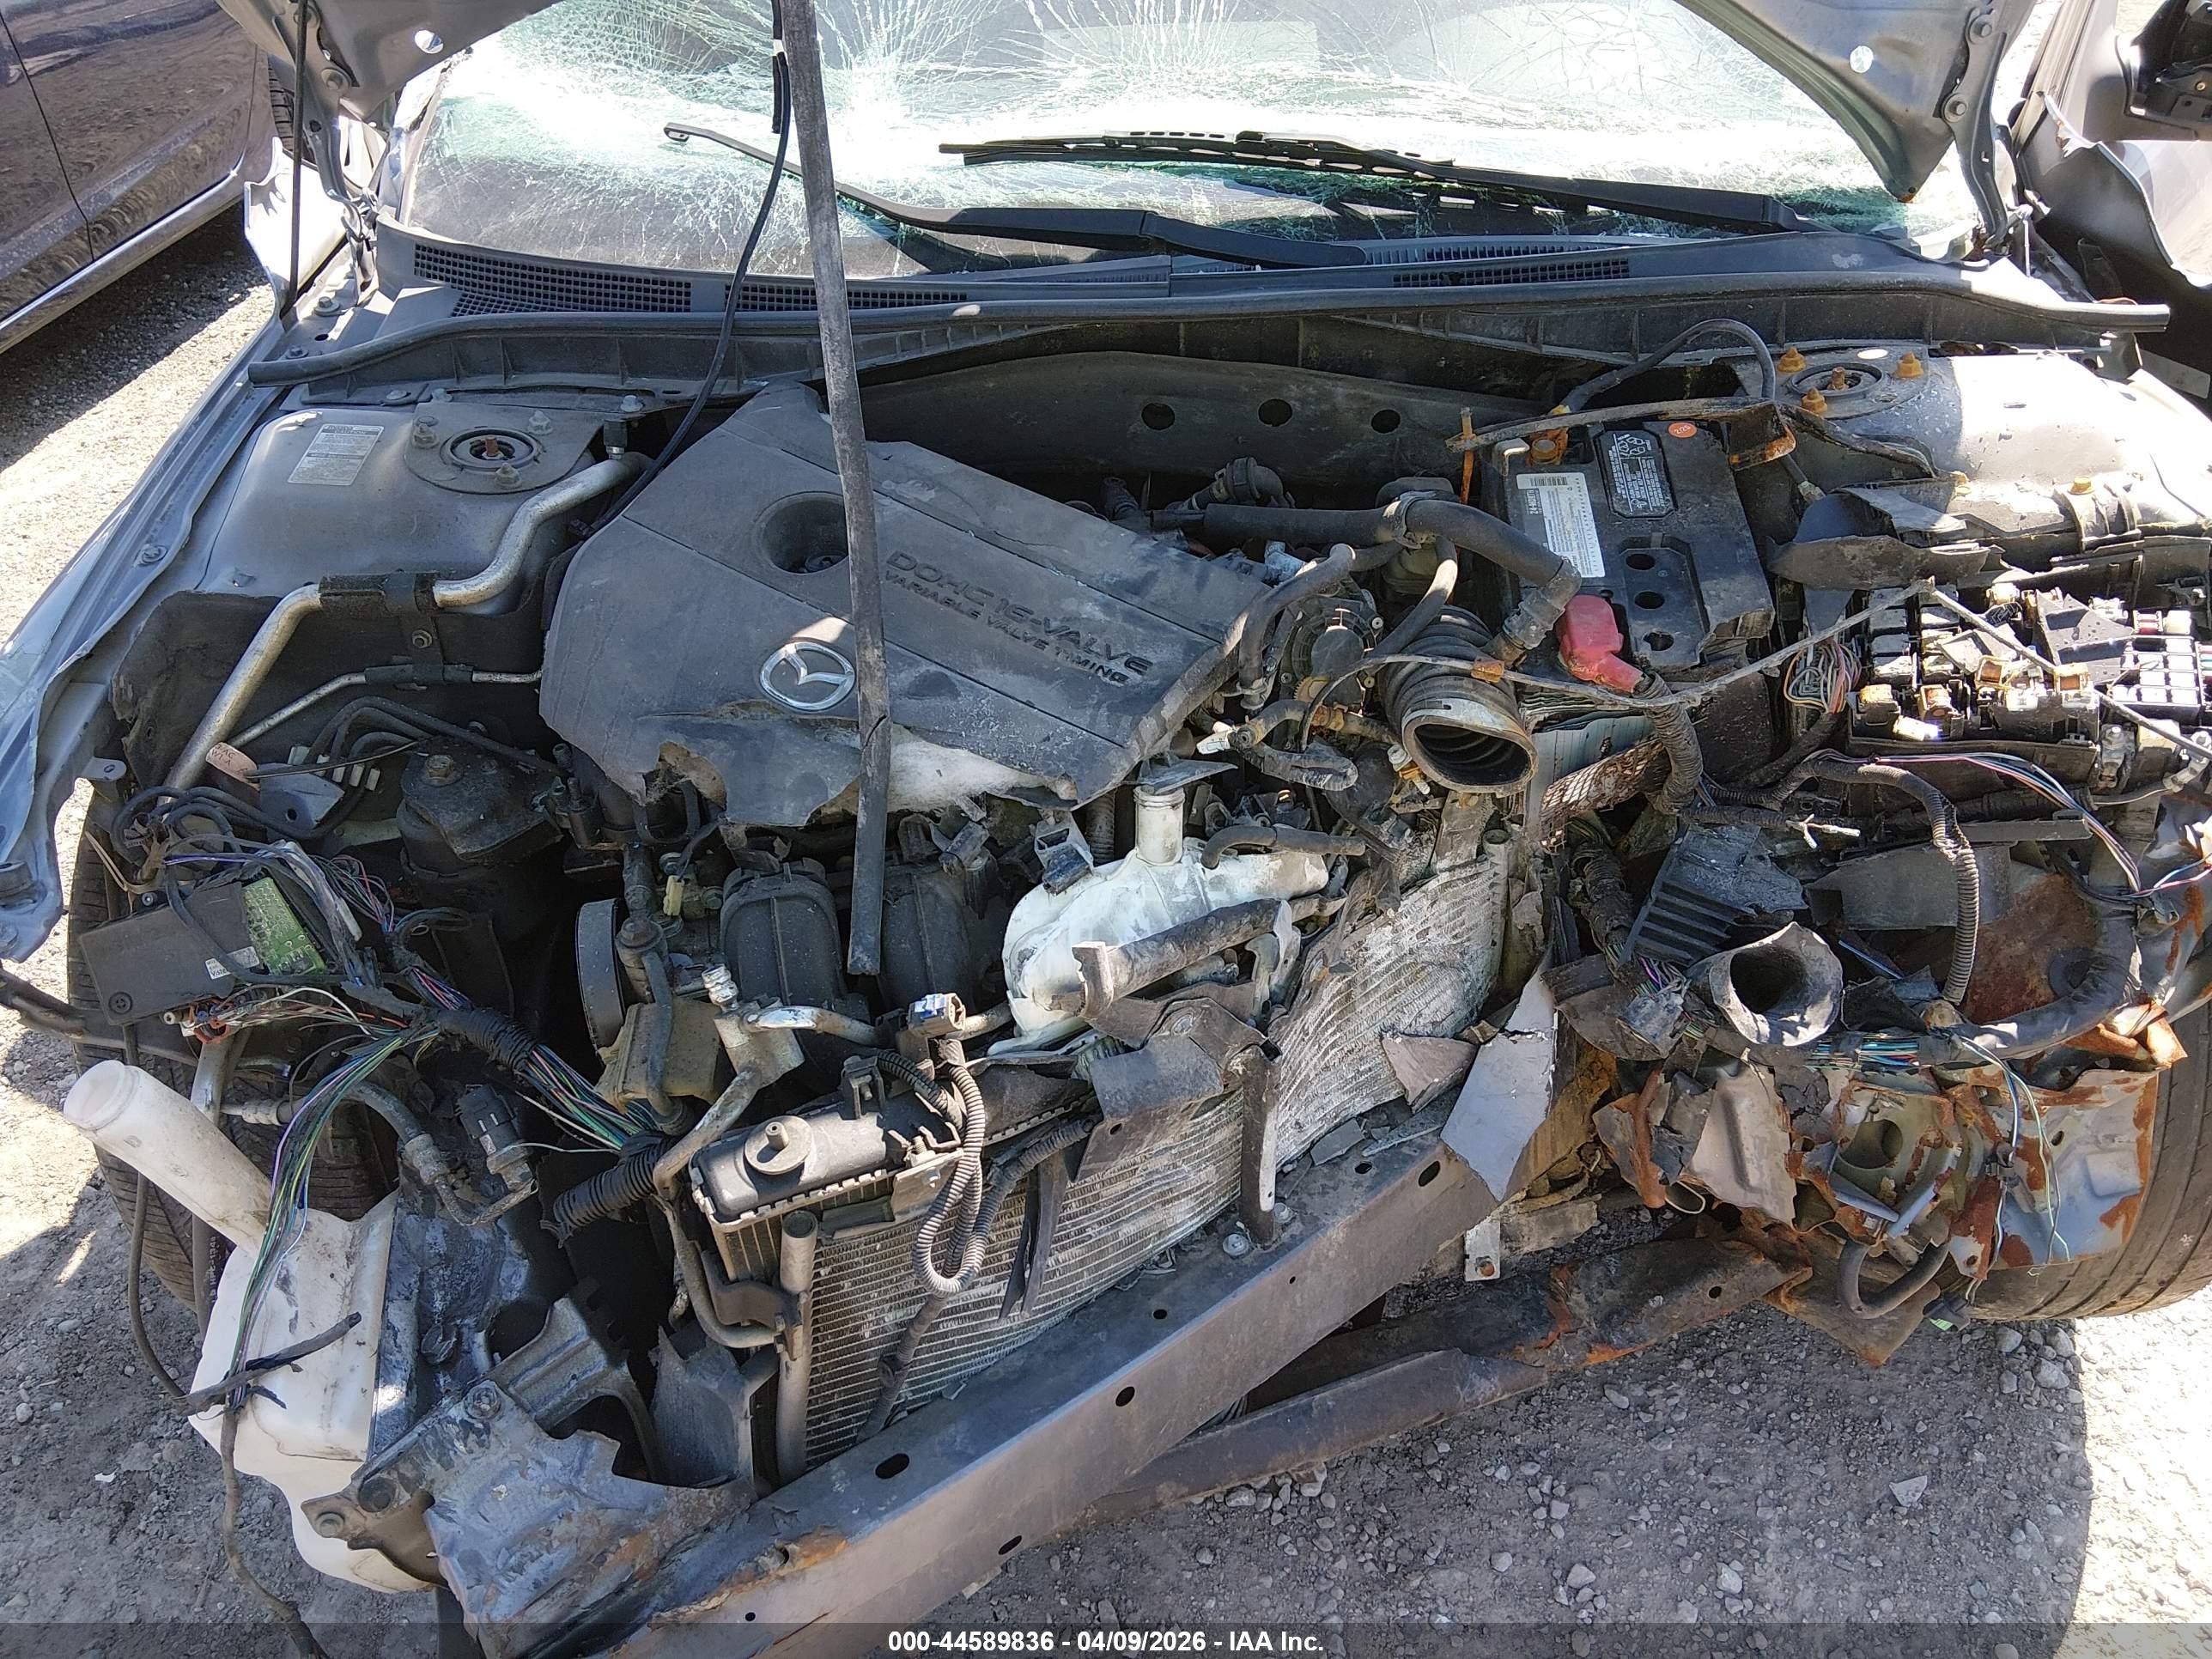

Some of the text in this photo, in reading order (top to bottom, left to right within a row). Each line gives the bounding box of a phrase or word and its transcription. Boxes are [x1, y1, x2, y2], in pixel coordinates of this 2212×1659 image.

[884, 570, 1130, 684] VARIABLE VALVE TIMING
[886, 550, 1153, 676] DOHC 16-VALVE
